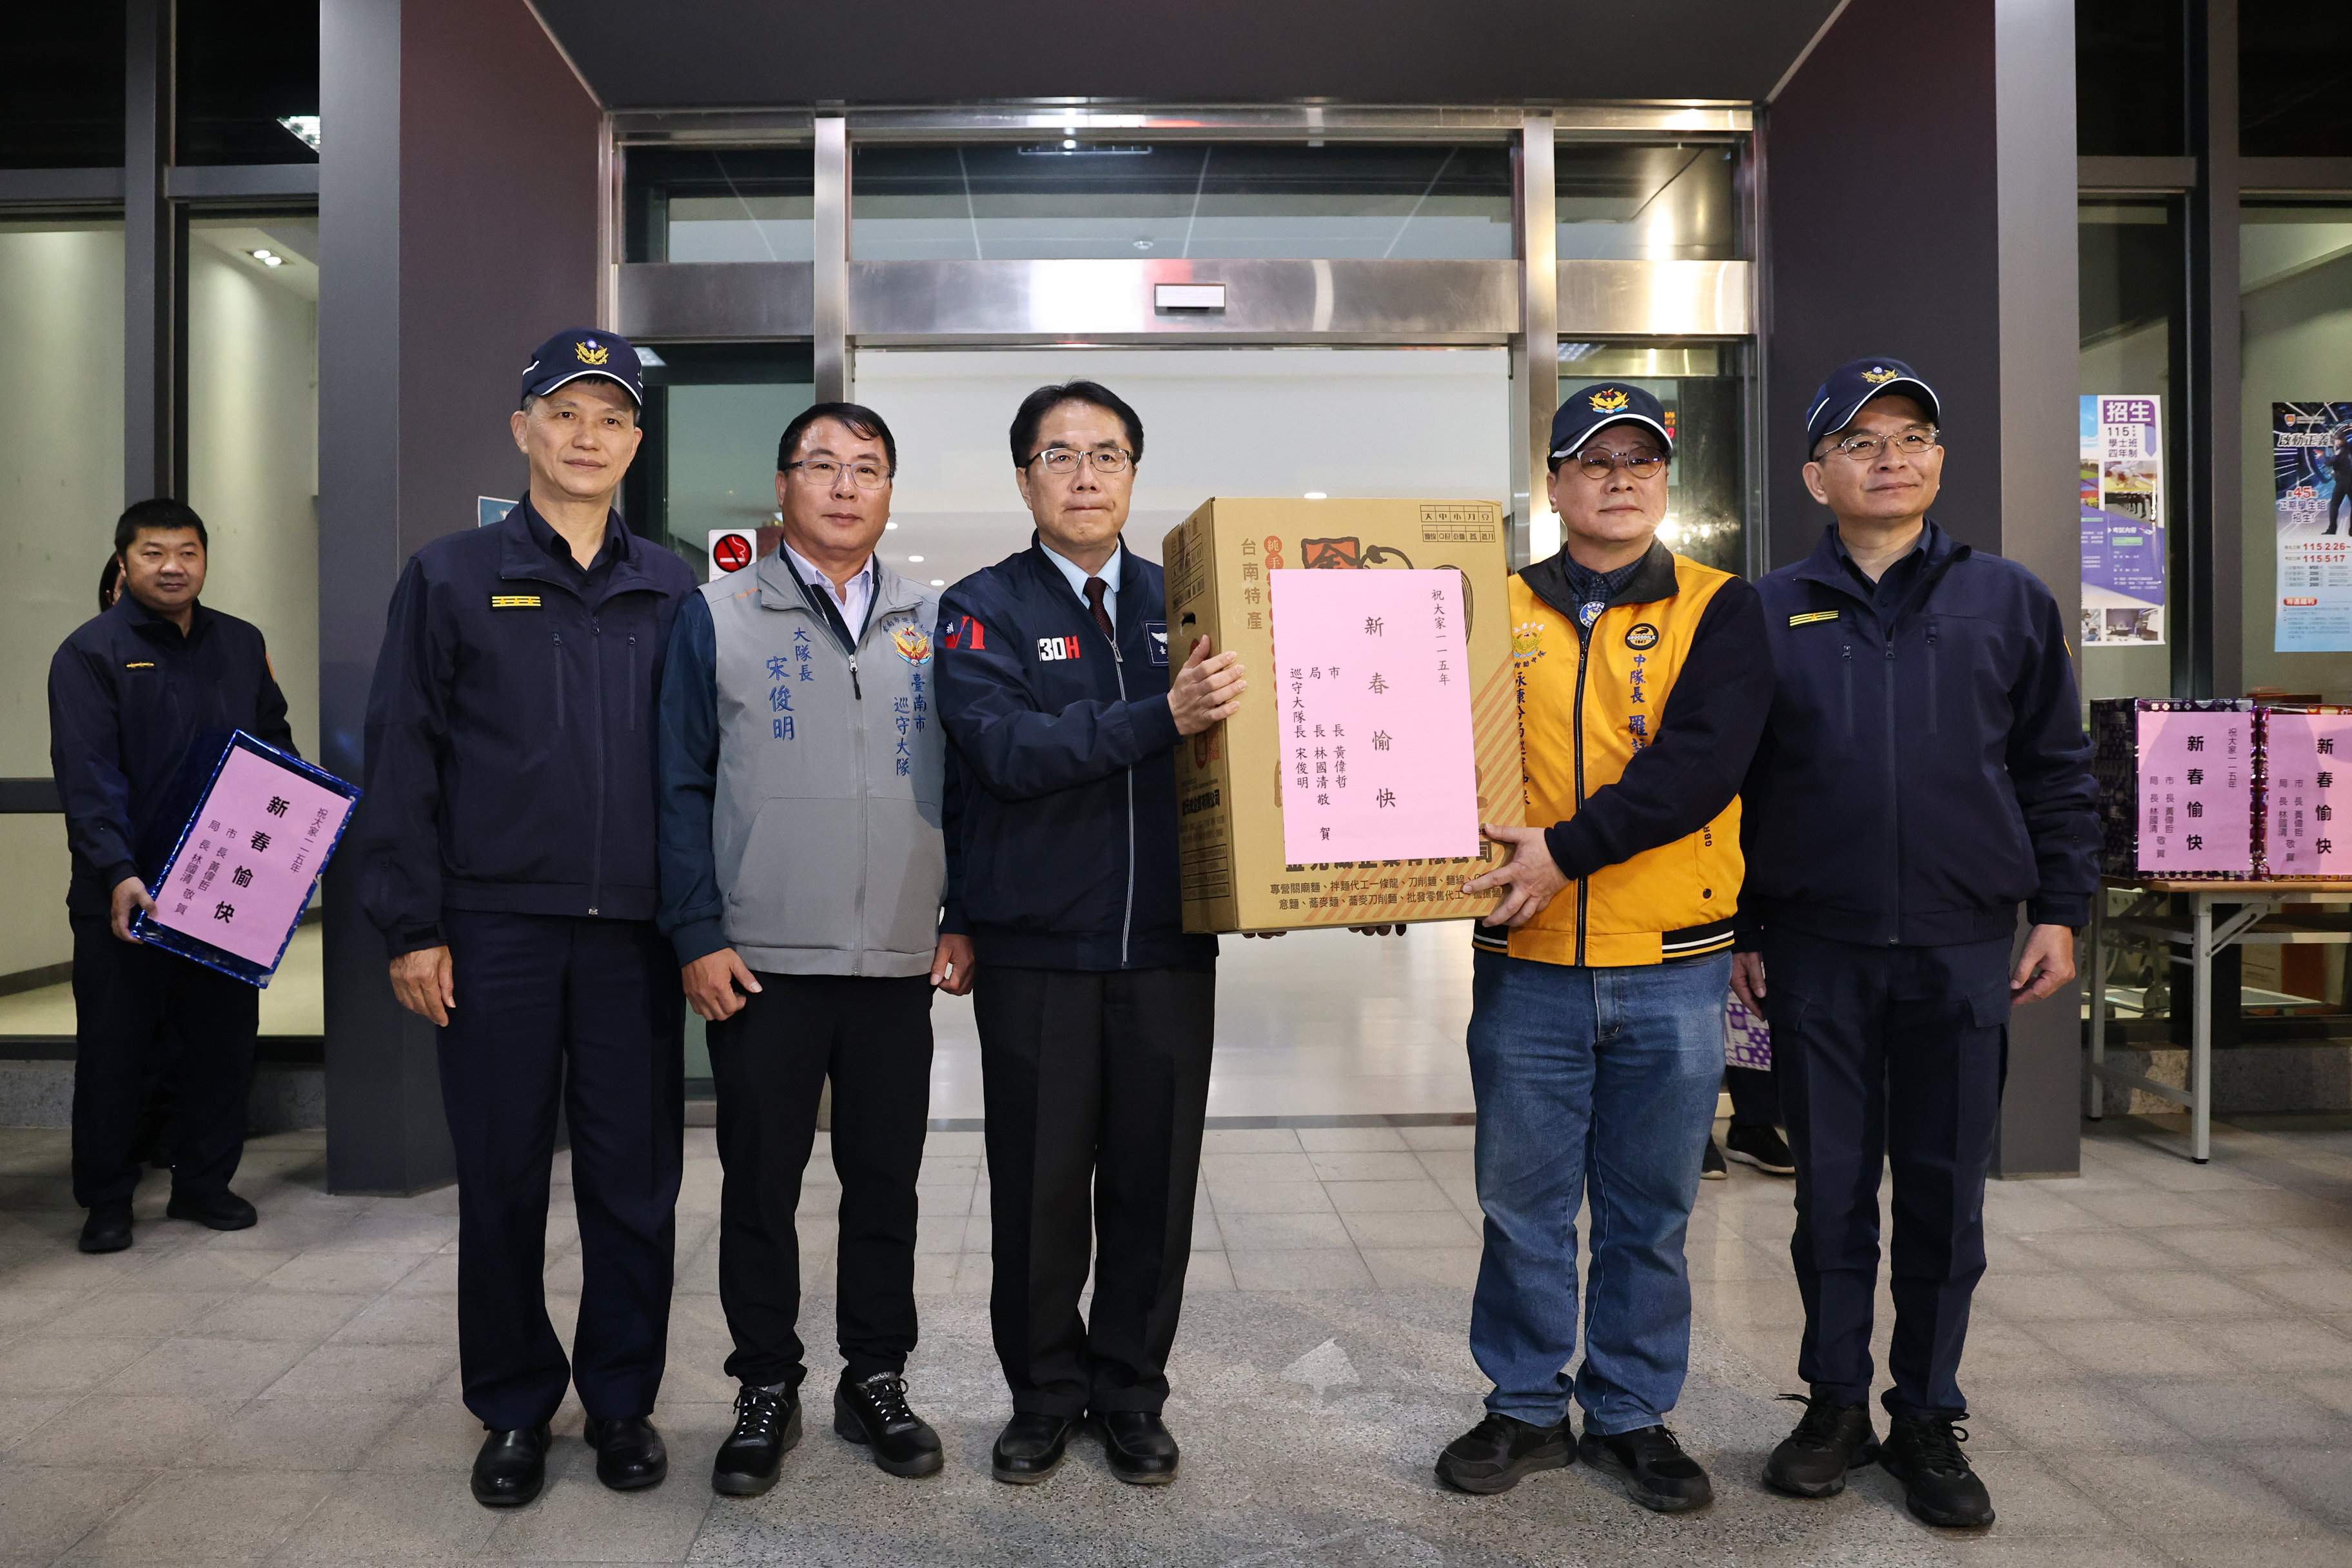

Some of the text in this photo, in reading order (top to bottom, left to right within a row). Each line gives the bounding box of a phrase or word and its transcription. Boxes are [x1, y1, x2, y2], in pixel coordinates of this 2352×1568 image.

[2106, 402, 2151, 422] 招生
[2108, 427, 2130, 436] 115
[2108, 438, 2138, 447] 學士班
[2109, 449, 2137, 458] 四年制
[1241, 538, 1262, 630] 台南特產
[793, 627, 814, 682] 大隊長
[1037, 635, 1081, 662] 30H
[1432, 589, 1450, 686] 祝大家一一五年
[766, 655, 796, 741] 宋俊明
[911, 672, 926, 734] 臺南市
[1630, 653, 1647, 704] 中隊長
[894, 696, 912, 776] 巡守大隊
[1290, 668, 1309, 789] 巡守大隊長宋俊明
[1309, 667, 1329, 789] 局長林國清
[1328, 666, 1348, 789] 市長黃偉哲
[1364, 616, 1396, 808] 新春愉快
[2228, 727, 2237, 789] 祝大家一一五年
[1317, 793, 1331, 841] 敬賀
[2186, 735, 2204, 851] 新春愉快
[2315, 738, 2334, 855] 新春愉快
[179, 819, 220, 885] 局長林國清
[198, 828, 237, 892] 市長黃偉哲
[213, 796, 291, 924] 新春愉快
[289, 807, 328, 874] 祝大家一一五年
[2157, 836, 2166, 858] 敬賀
[174, 888, 195, 916] 敬賀
